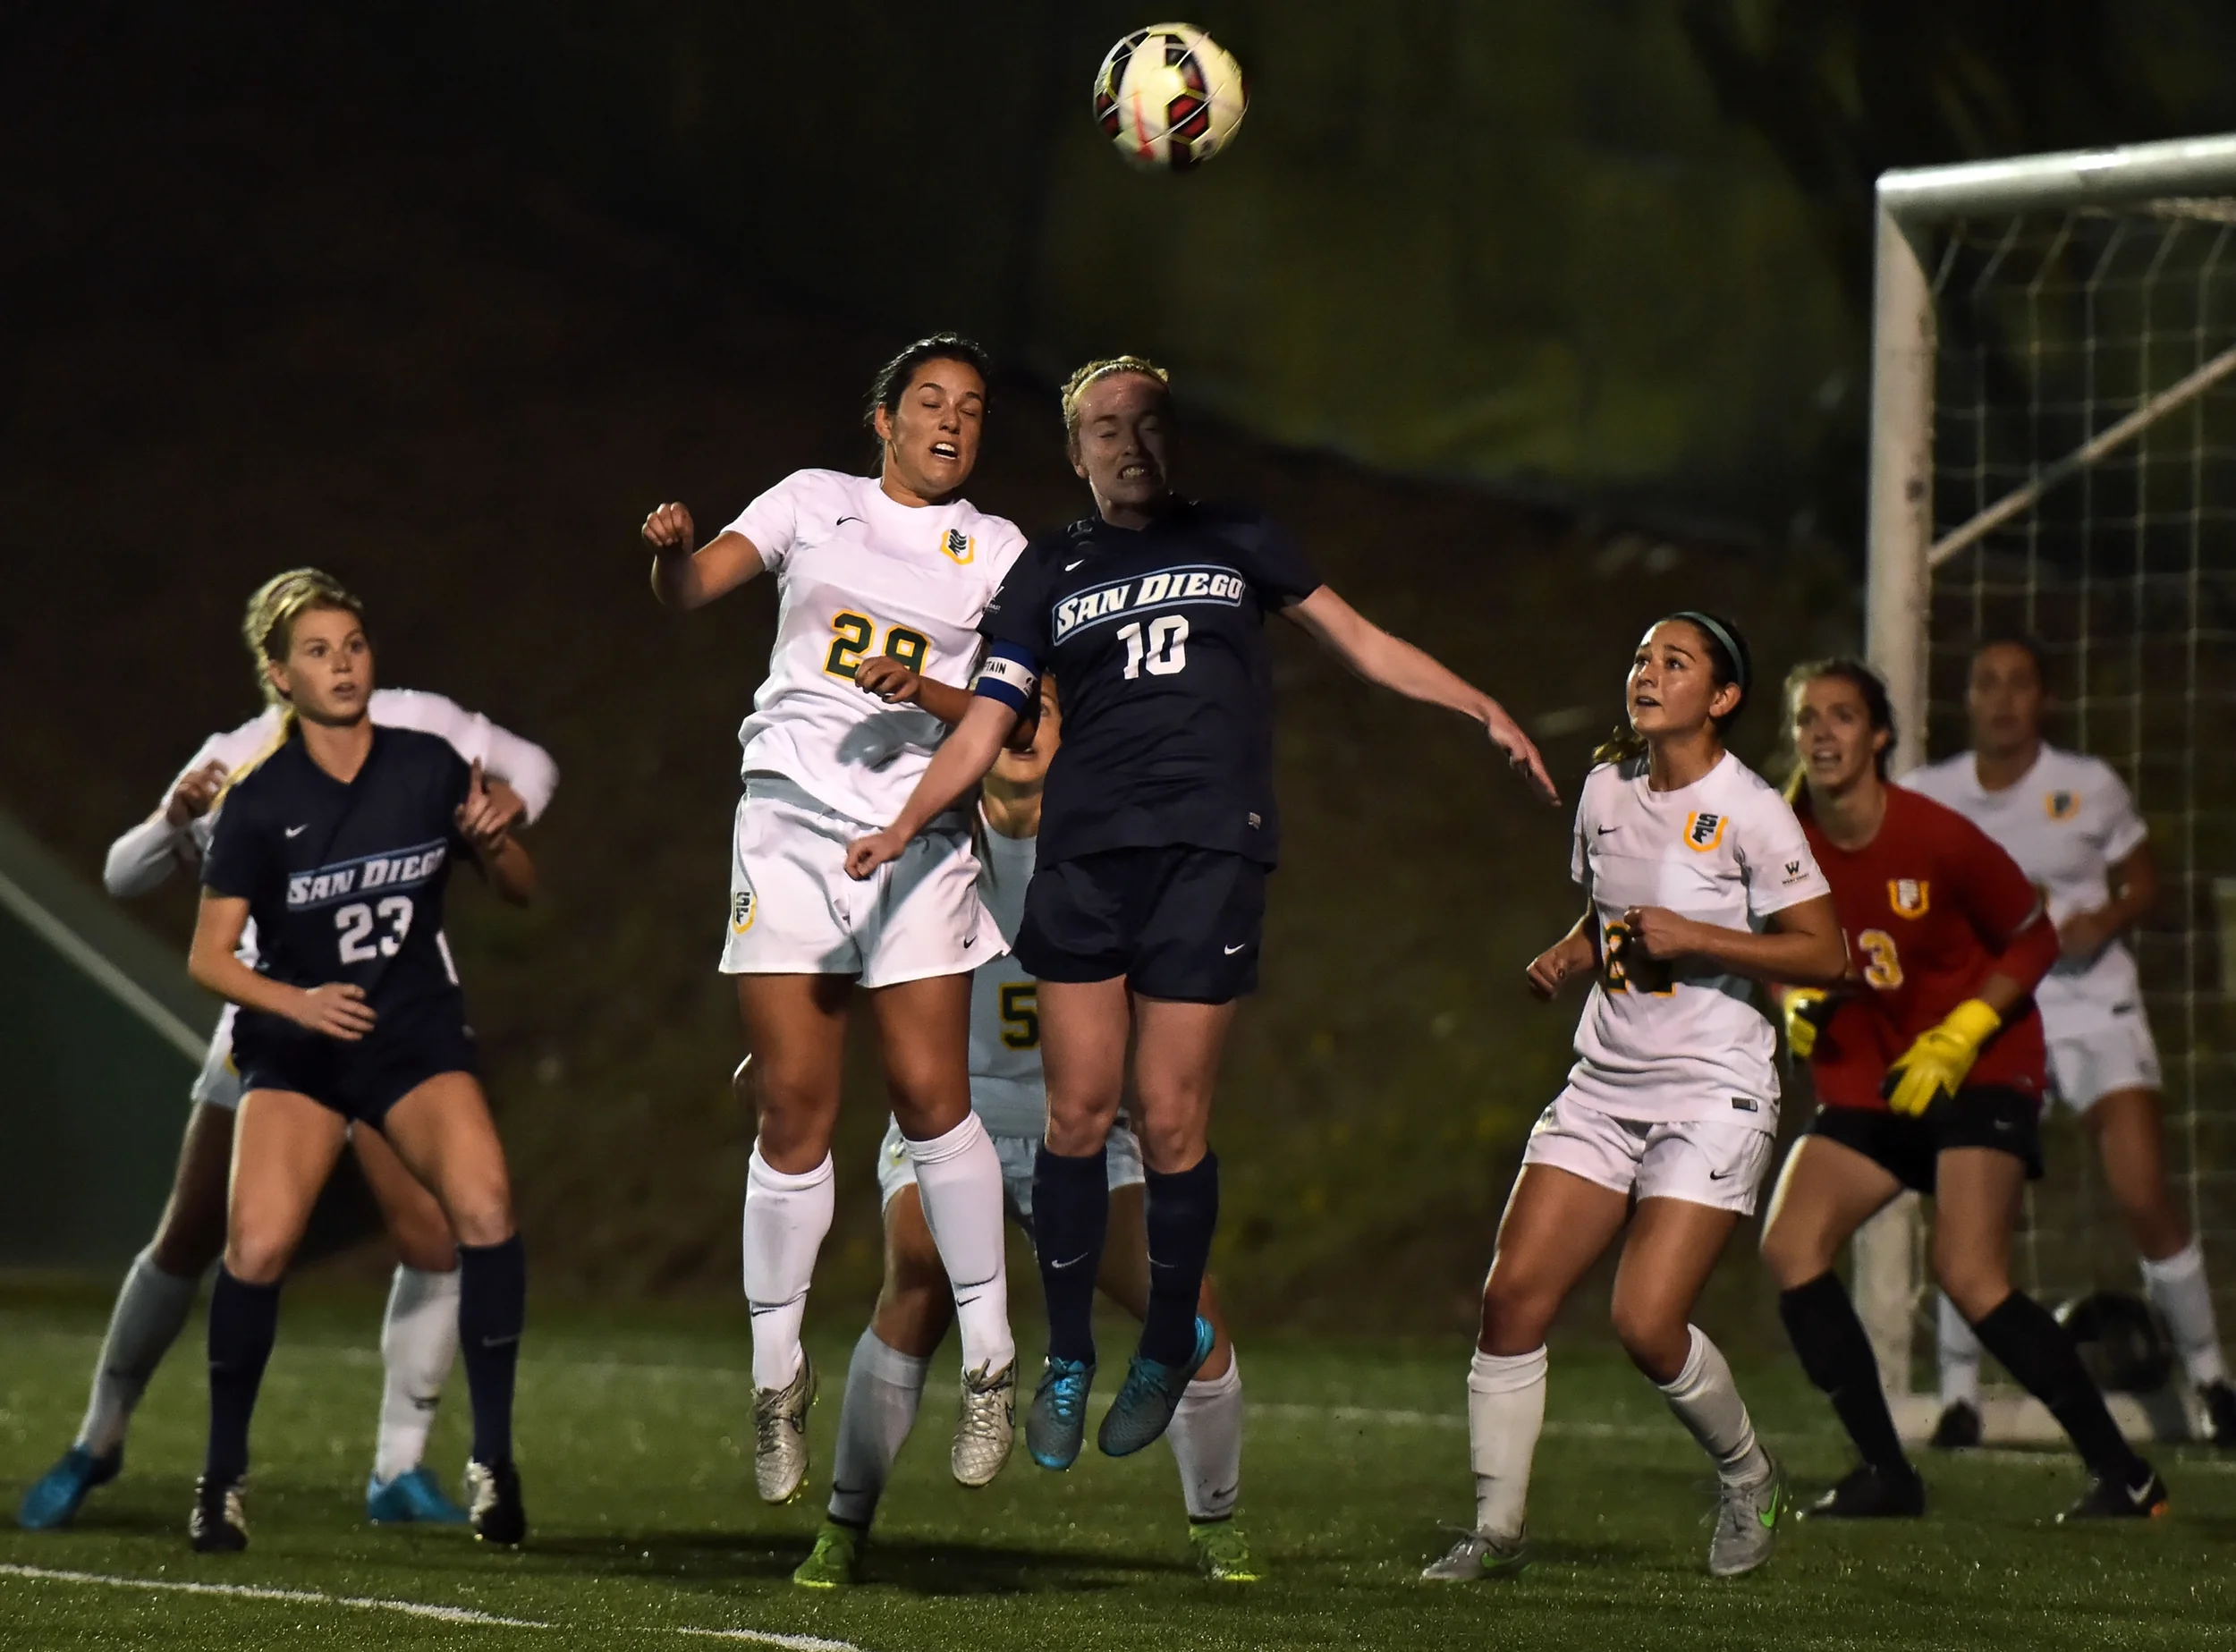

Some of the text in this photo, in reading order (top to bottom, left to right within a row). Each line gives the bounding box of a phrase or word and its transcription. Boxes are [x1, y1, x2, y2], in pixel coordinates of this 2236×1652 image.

[1056, 572, 1243, 639] SAN DIEGO
[1116, 614, 1190, 680] 10
[287, 868, 356, 905] SAN
[335, 895, 413, 965] 23
[998, 982, 1039, 1051] 5
